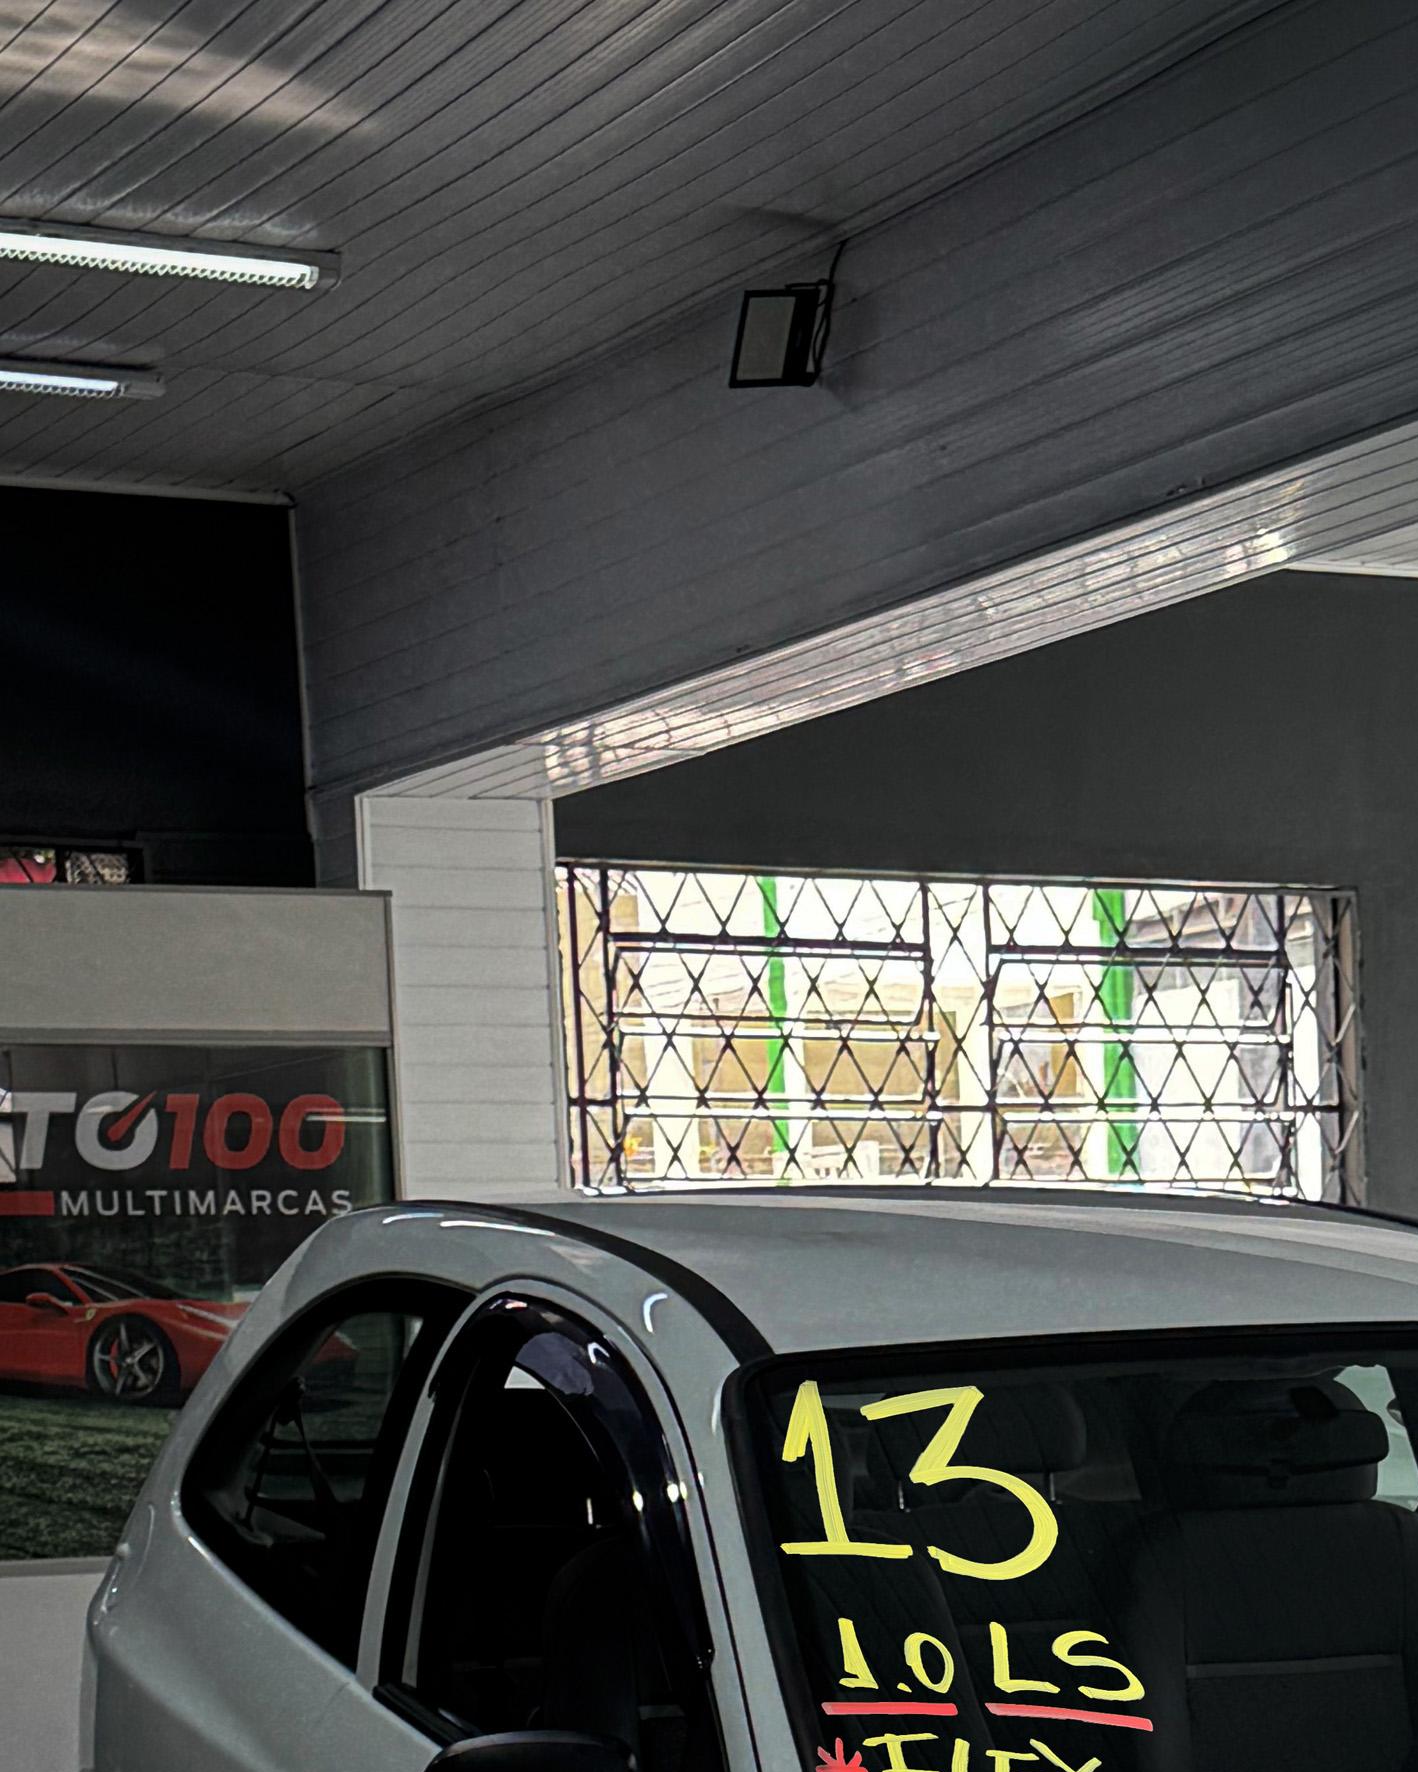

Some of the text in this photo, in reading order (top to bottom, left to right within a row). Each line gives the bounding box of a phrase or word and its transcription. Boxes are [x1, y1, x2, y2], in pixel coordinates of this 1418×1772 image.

[60, 1189, 352, 1216] MULTIMARCAS
[781, 1380, 1059, 1580] 13
[838, 1618, 1145, 1700] 1.0 LS
